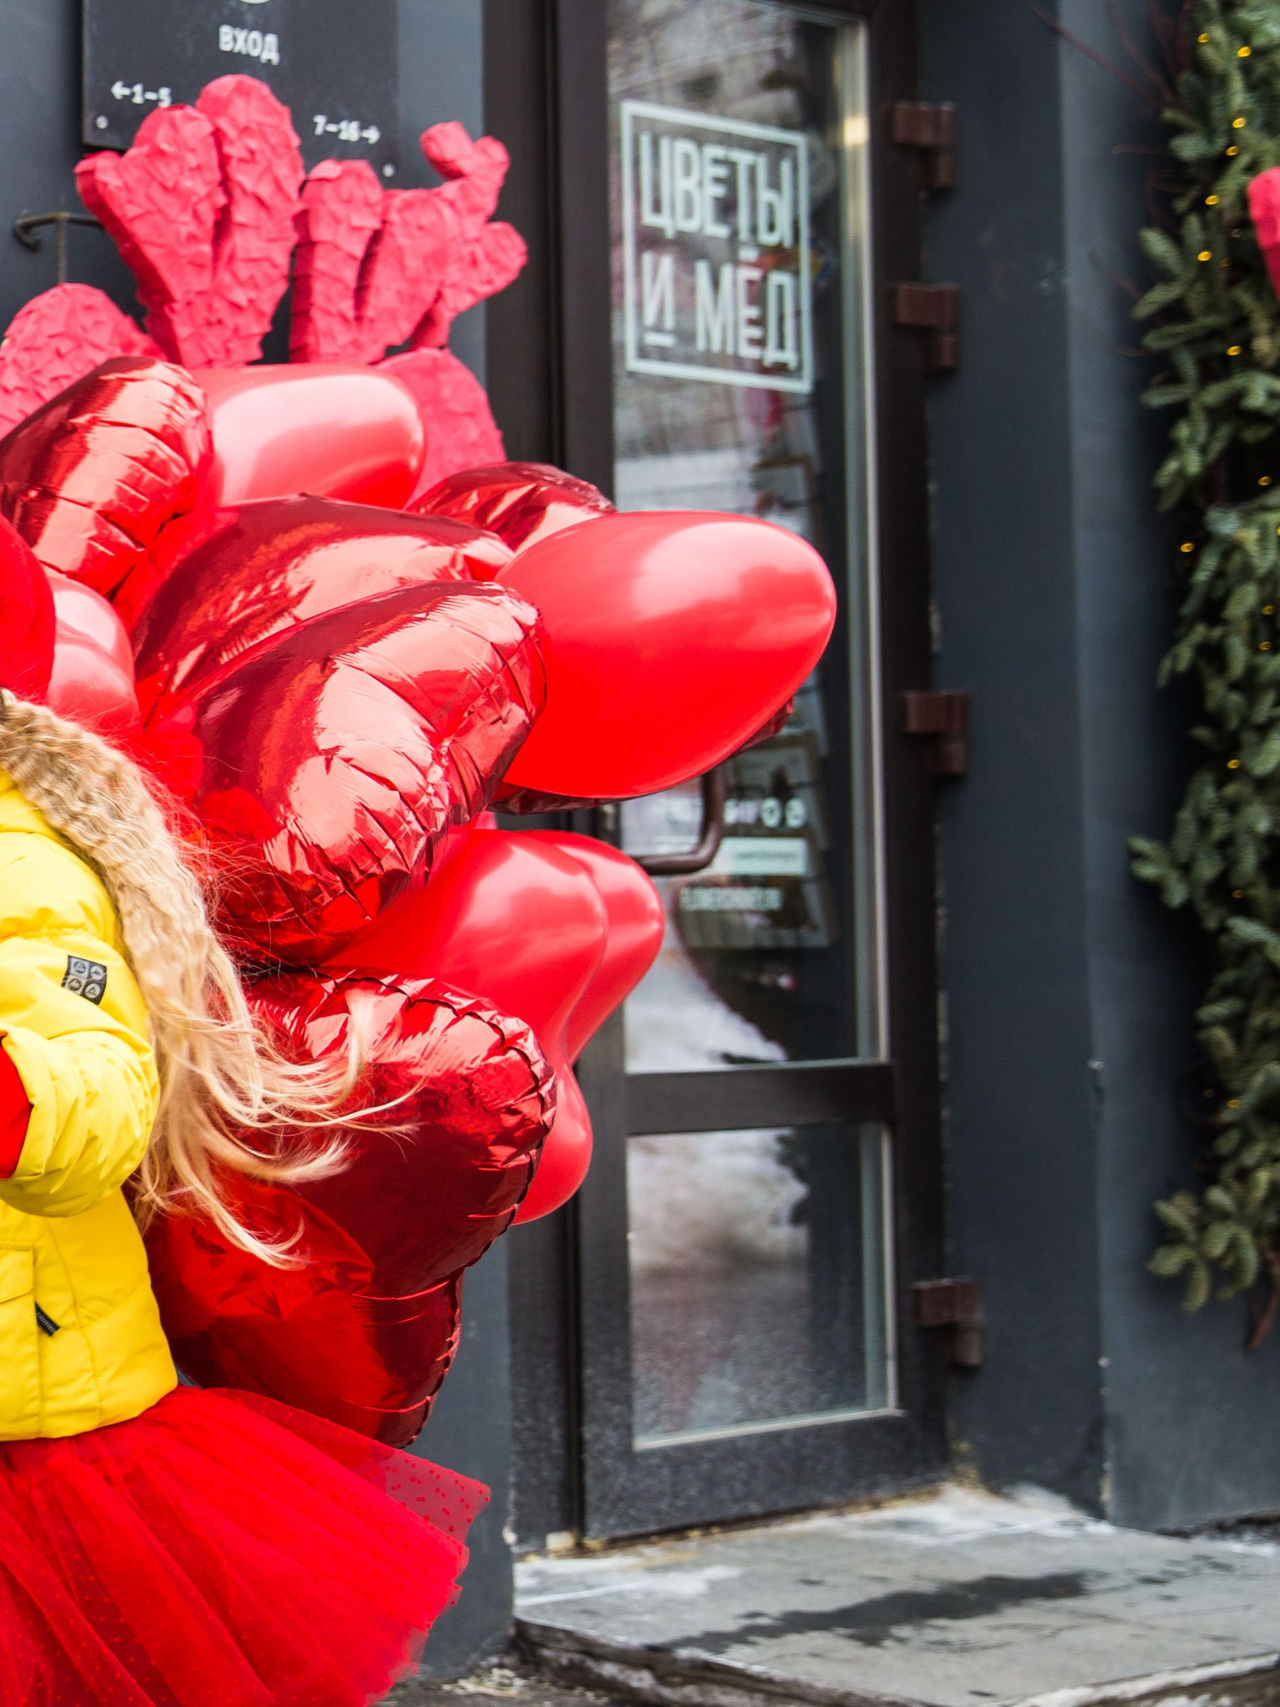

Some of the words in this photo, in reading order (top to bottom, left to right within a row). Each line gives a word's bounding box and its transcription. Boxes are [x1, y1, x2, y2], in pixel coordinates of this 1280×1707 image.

[219, 25, 280, 65] ВХОД
[638, 130, 794, 249] ЦВЕТЫ
[641, 252, 677, 347] И
[695, 247, 799, 371] МЁД
